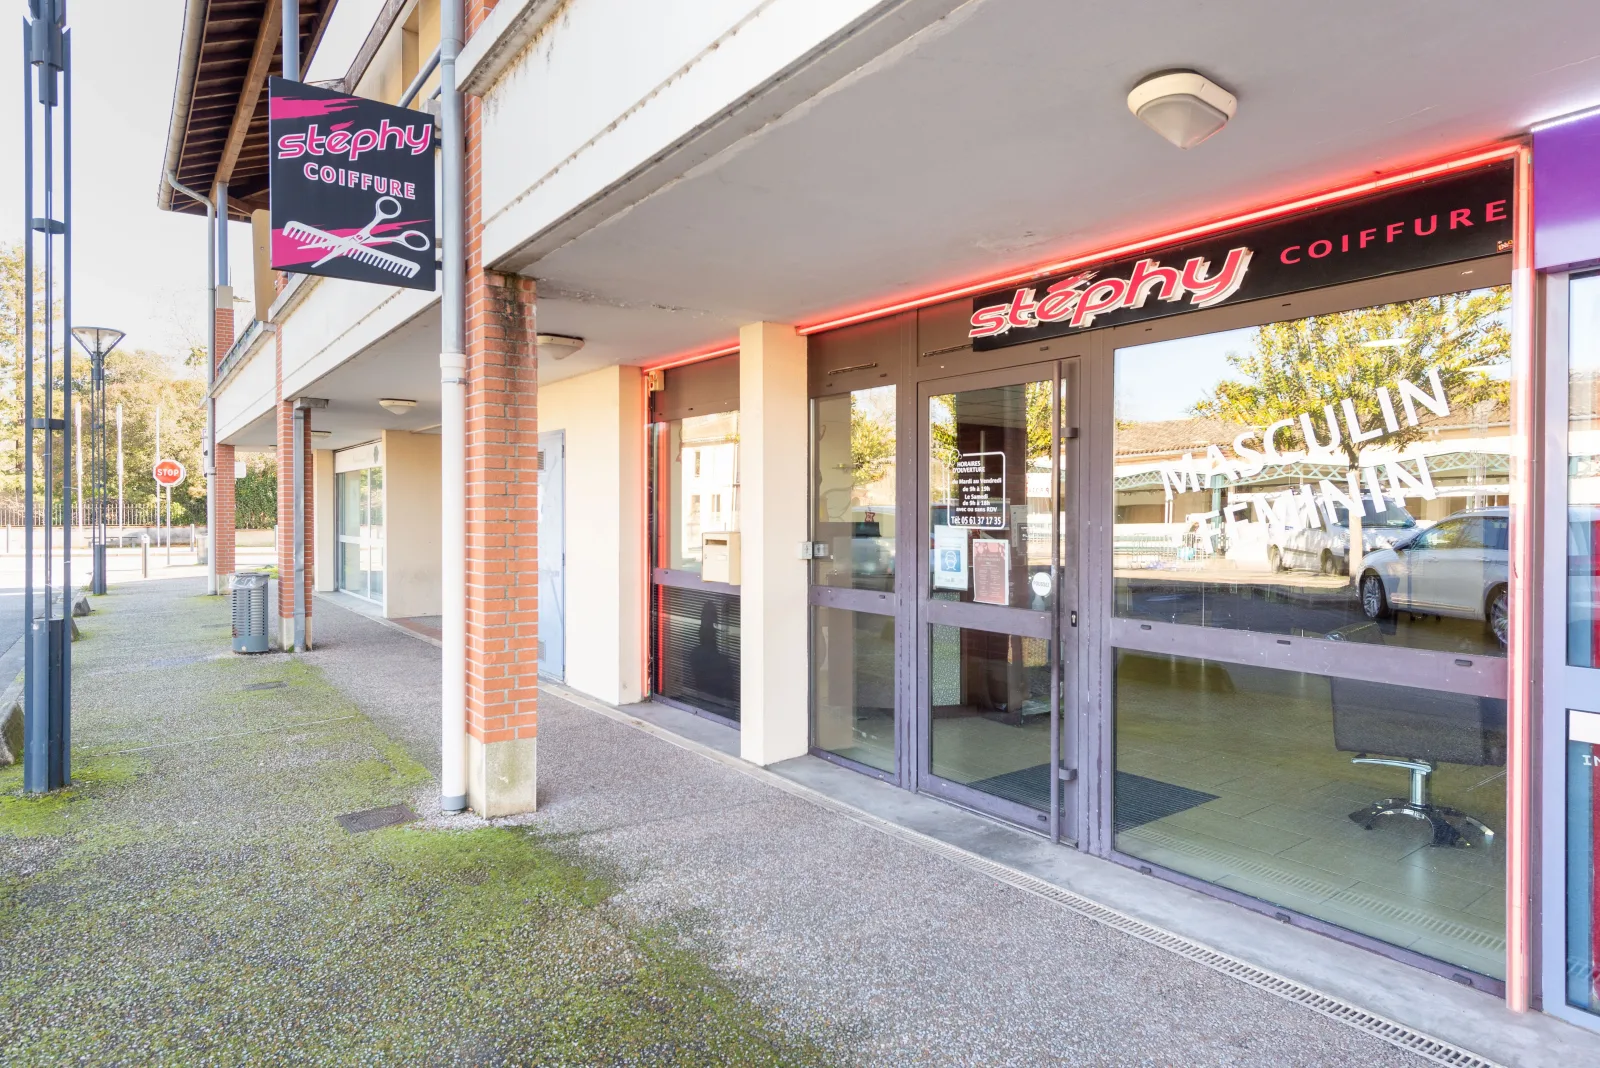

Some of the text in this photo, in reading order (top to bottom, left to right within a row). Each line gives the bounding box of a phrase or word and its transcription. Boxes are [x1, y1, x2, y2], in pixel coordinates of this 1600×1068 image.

[278, 119, 432, 161] stéphy
[303, 162, 416, 200] COIFFURE
[968, 199, 1507, 339] stéphy COIFFURE
[1159, 368, 1450, 501] MASCULIN
[157, 469, 179, 477] STOP
[961, 516, 968, 524] 05
[969, 516, 976, 524] 61
[977, 516, 985, 525] 37
[986, 516, 993, 525] 17
[993, 516, 1001, 525] 35
